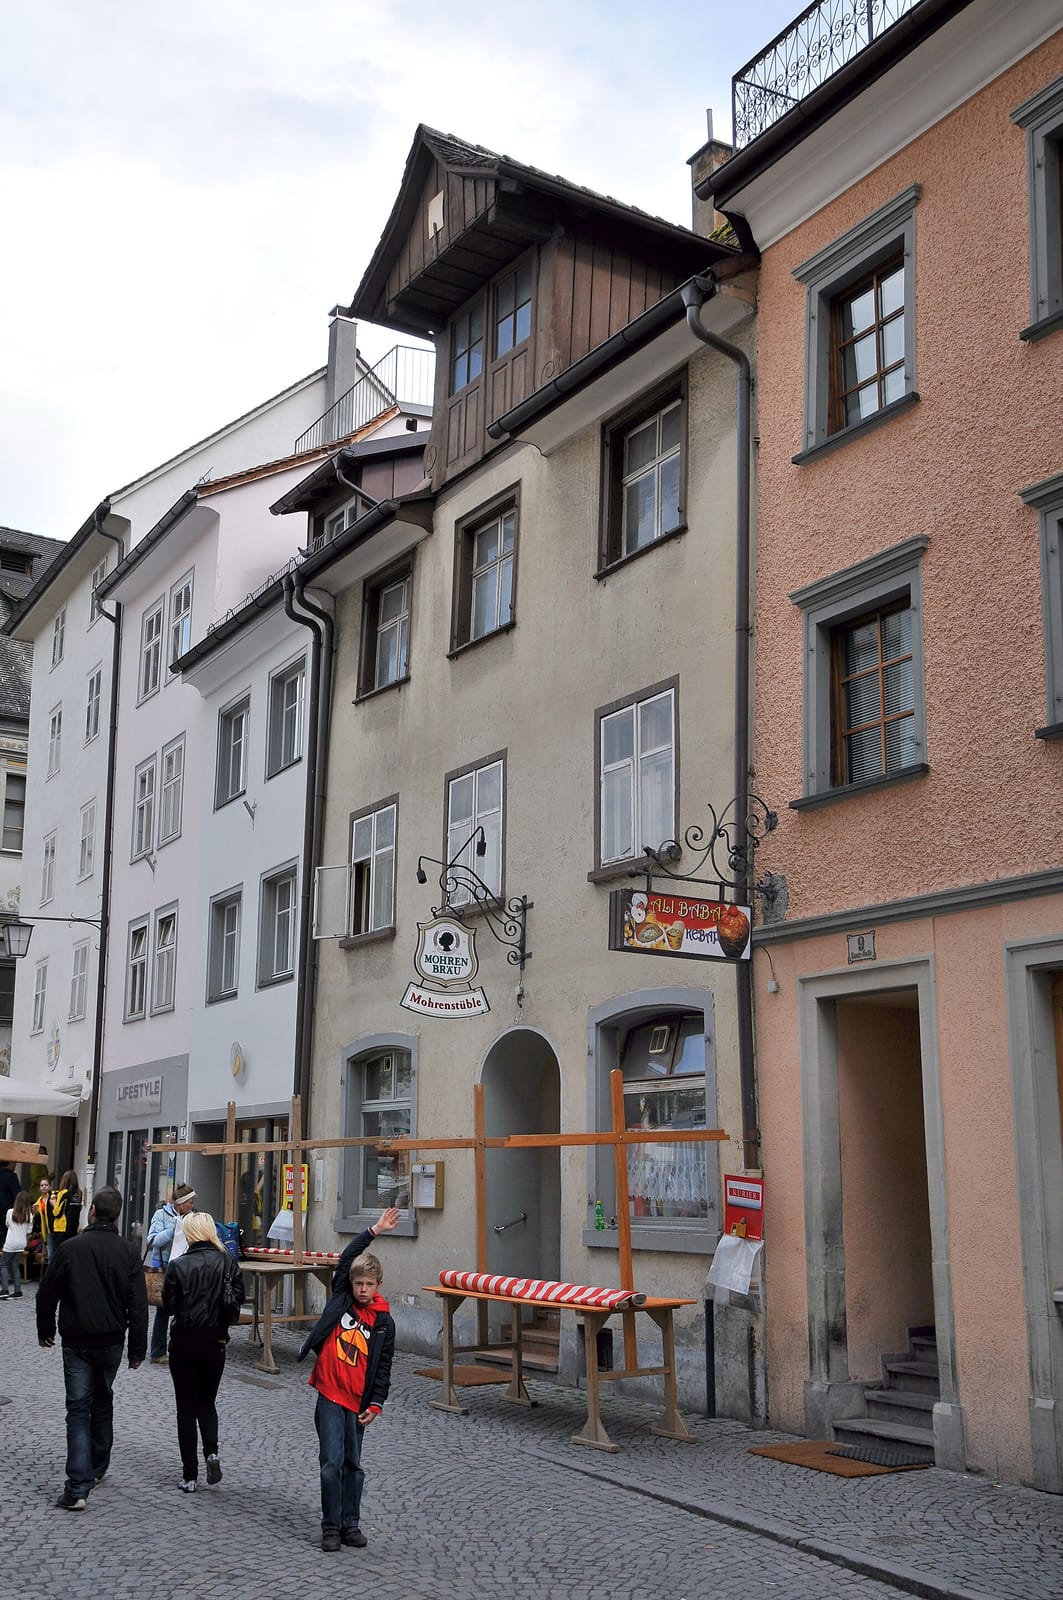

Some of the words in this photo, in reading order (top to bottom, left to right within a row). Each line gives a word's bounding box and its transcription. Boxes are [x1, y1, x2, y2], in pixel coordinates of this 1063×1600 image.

[650, 898, 675, 914] ALI
[678, 901, 721, 922] BABA
[857, 935, 865, 952] 9
[424, 954, 469, 967] MOHREN
[432, 964, 462, 976] BRÄU
[409, 992, 482, 1010] Mohrenstüble
[117, 1080, 160, 1101] LIFESTYLE
[732, 1188, 757, 1200] KURIER
